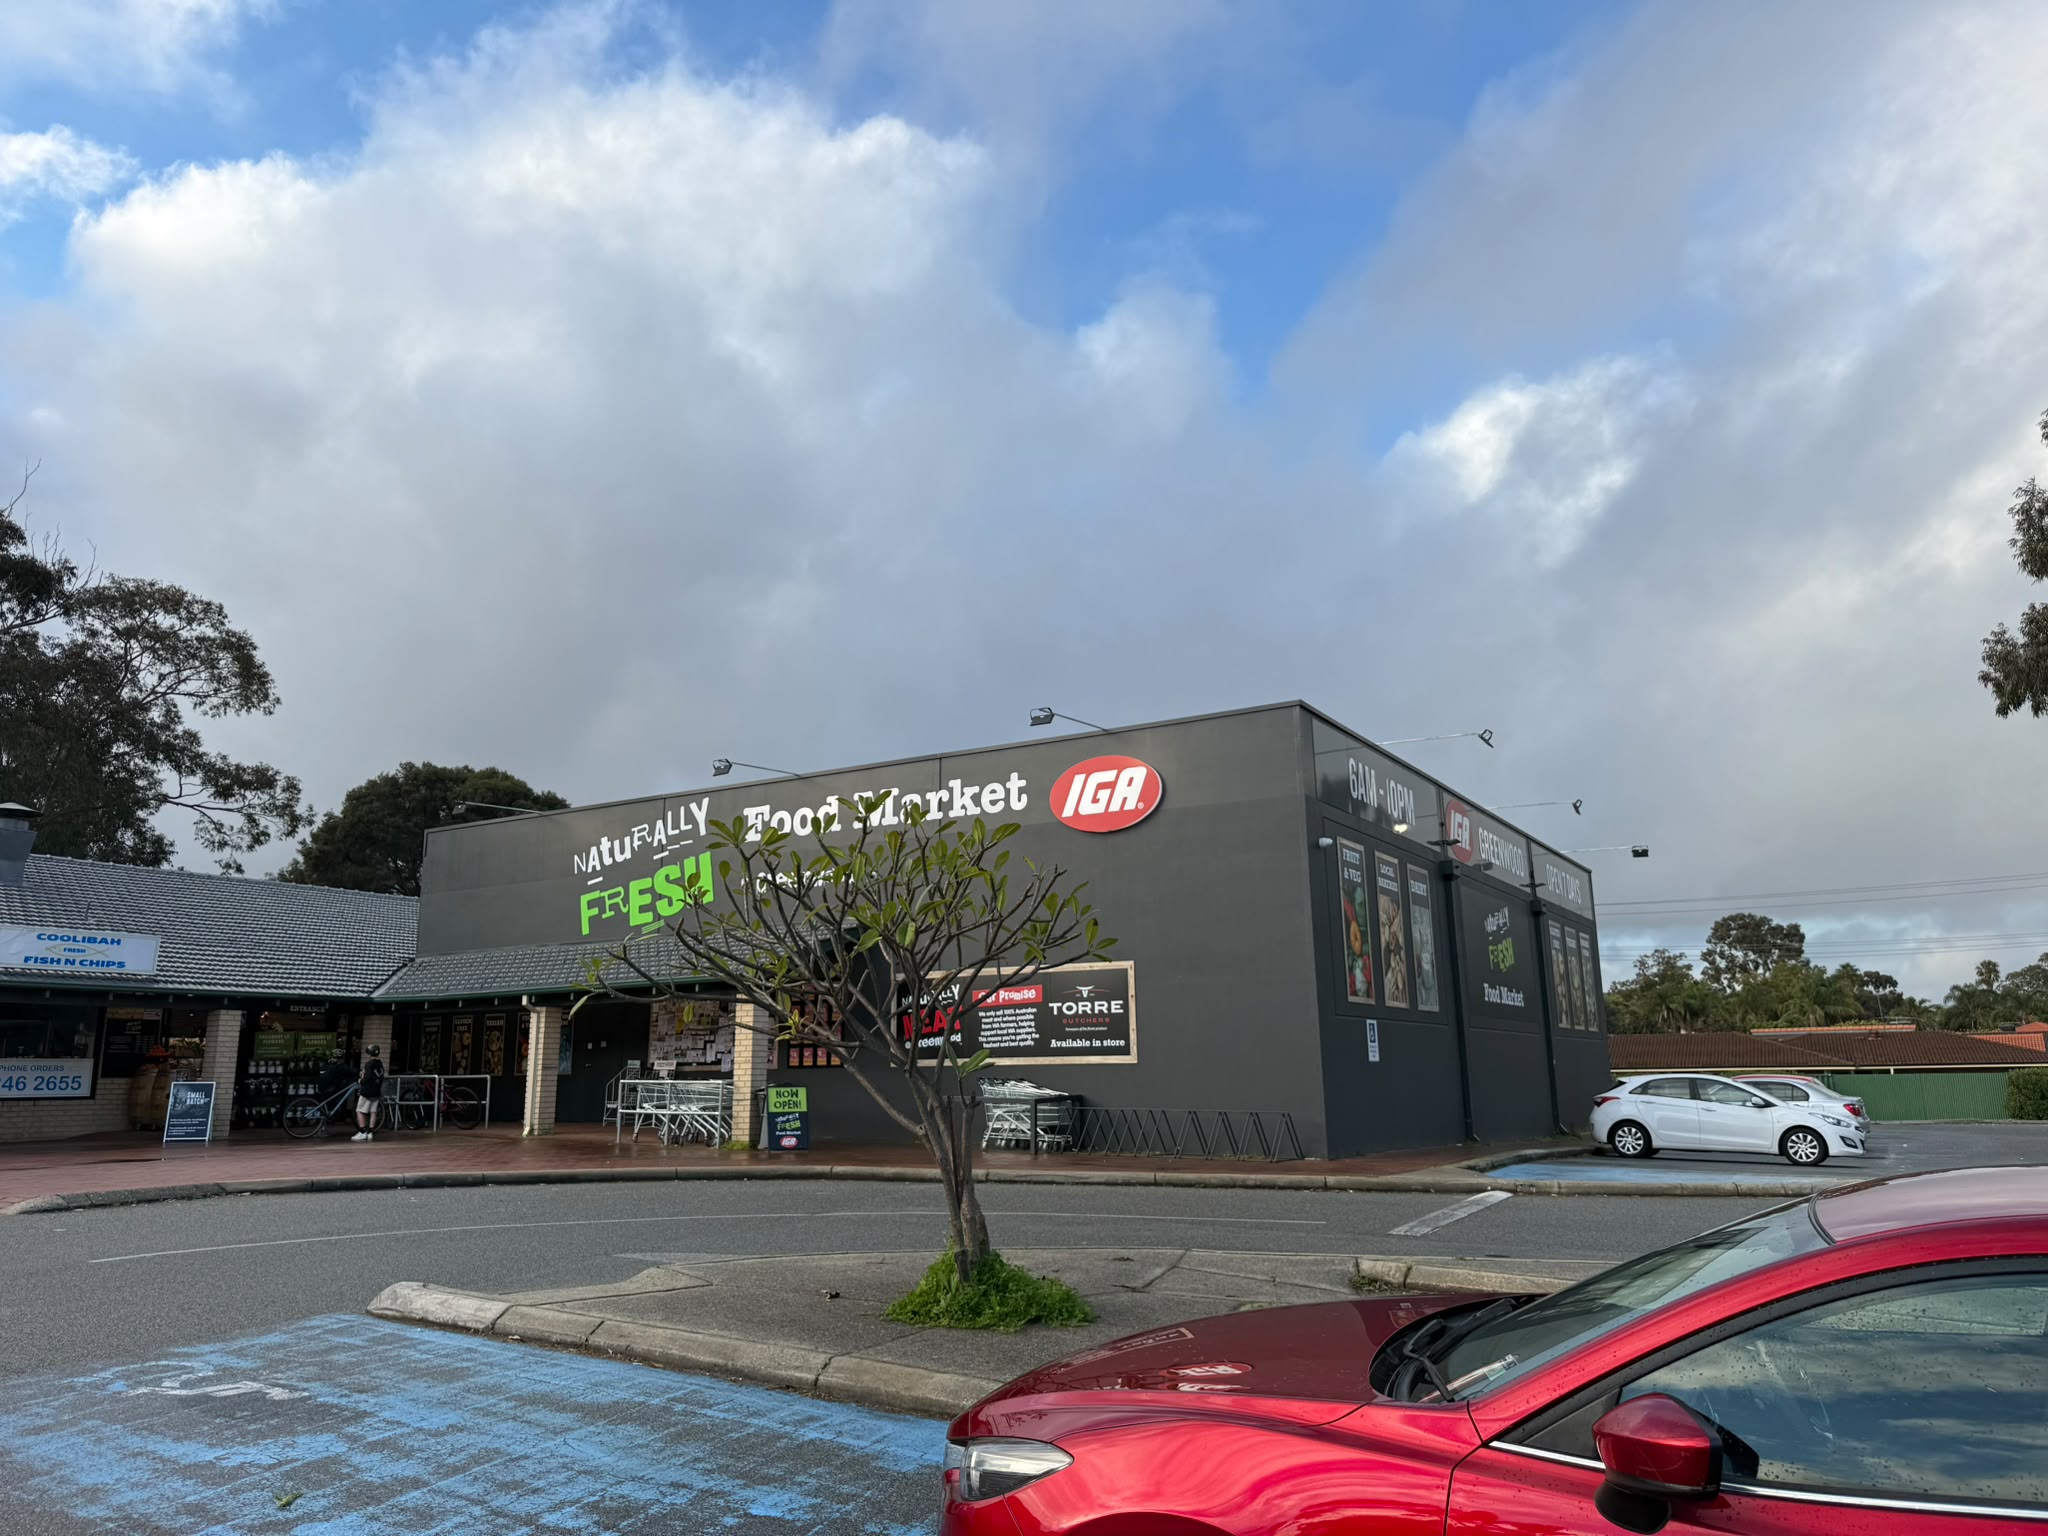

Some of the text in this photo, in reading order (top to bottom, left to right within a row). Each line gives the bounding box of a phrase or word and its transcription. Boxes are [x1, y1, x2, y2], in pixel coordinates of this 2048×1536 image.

[1060, 766, 1148, 818] IGA
[1349, 757, 1377, 808] 6AM
[1386, 777, 1416, 826] 10PM
[743, 771, 1028, 843] Food Market
[1450, 809, 1524, 877] IGA GREENWOOD
[1349, 867, 1361, 883] VEG
[580, 851, 715, 936] FRESH
[36, 932, 122, 946] COOLIBAH
[24, 956, 126, 969] FISH N CHIPS
[1483, 982, 1525, 1008] Food Market
[1048, 1000, 1124, 1015] TORRE
[1062, 1017, 1111, 1025] BUTCHERS
[1050, 1038, 1126, 1048] Available in store
[0, 1064, 65, 1072] PHONE ORDERS
[0, 1075, 82, 1091] 46 2655
[775, 1088, 799, 1099] NOW
[774, 1099, 802, 1110] OPEN!
[781, 1137, 797, 1146] IGA
